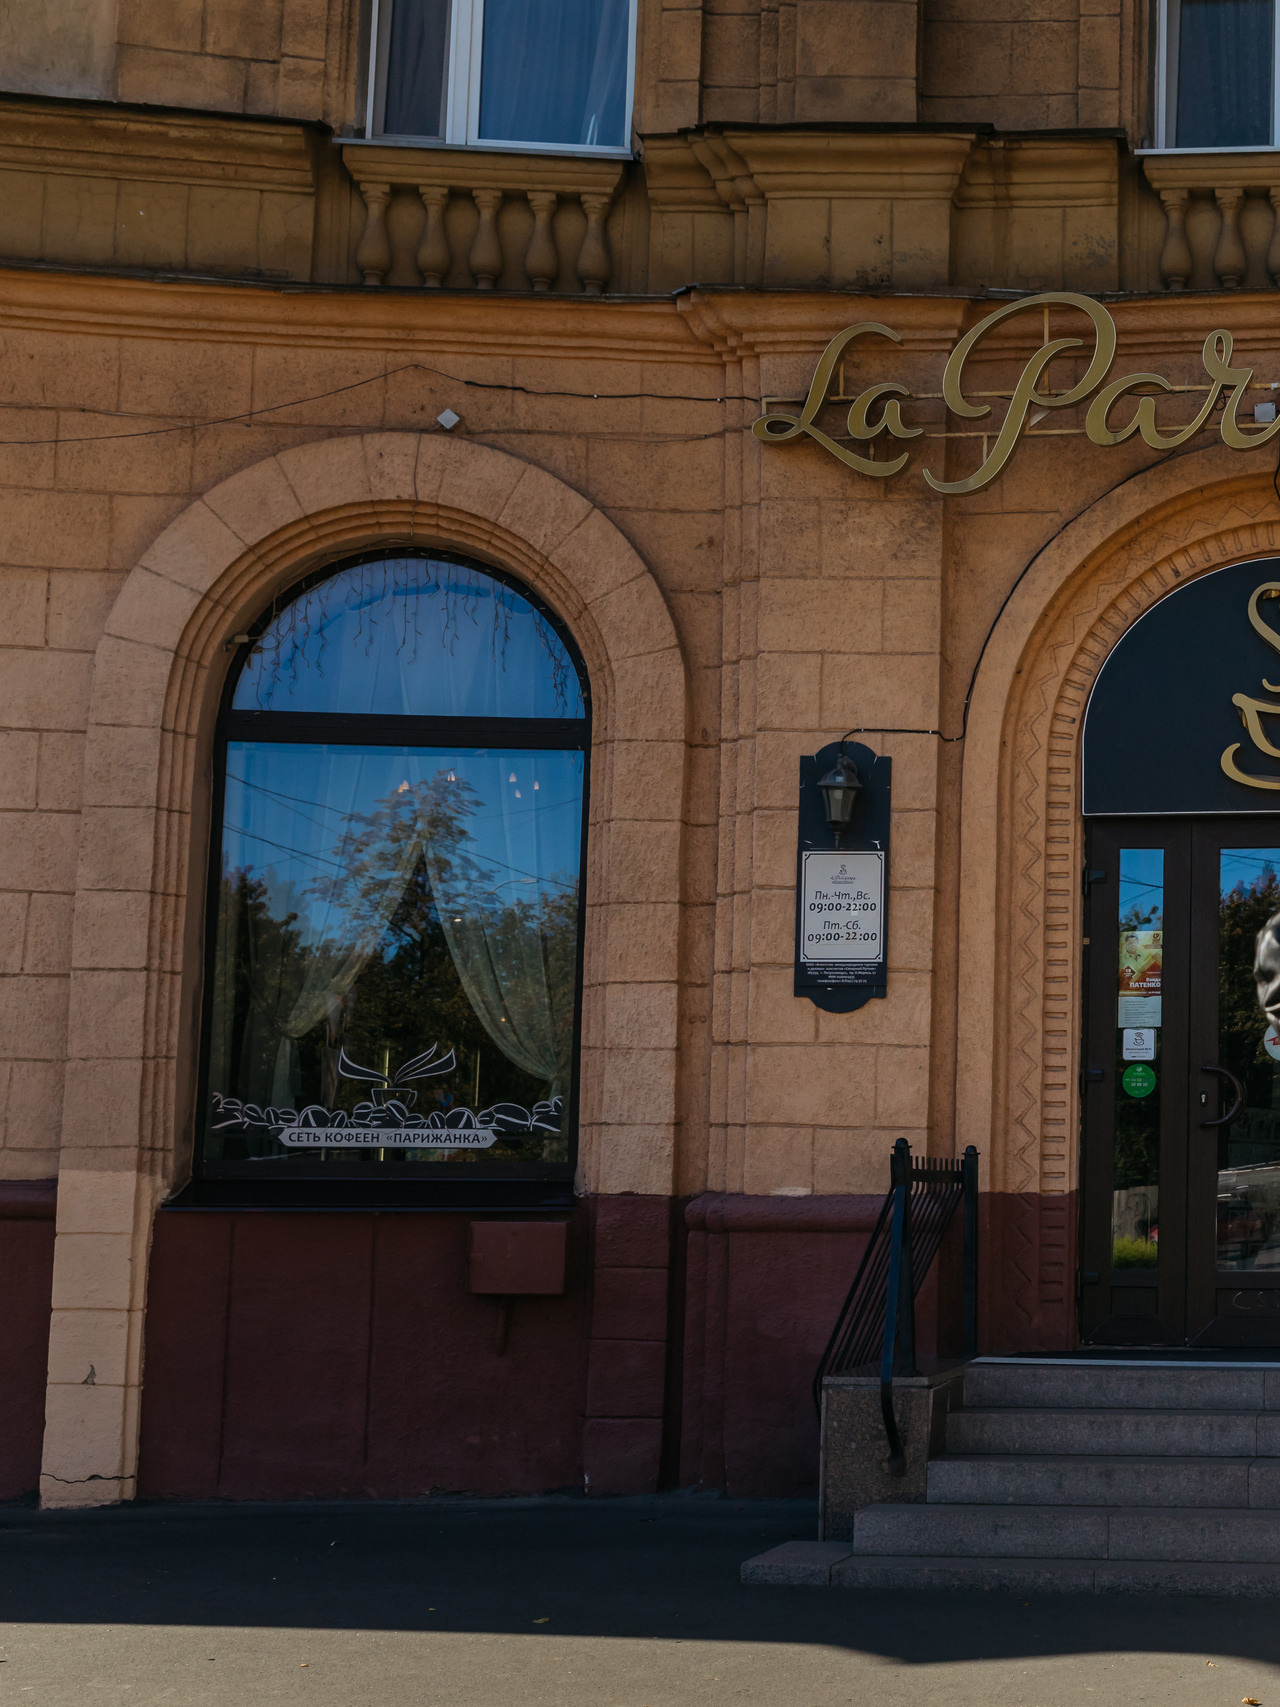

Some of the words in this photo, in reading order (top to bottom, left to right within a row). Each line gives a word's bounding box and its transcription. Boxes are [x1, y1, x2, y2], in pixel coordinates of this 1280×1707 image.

[753, 321, 925, 477] La
[809, 902, 877, 914] 09:00-22:00
[823, 920, 861, 930] Пт.-Сб.
[288, 1132, 321, 1144] СЕТЬ
[324, 1132, 381, 1144] КОФЕЕН
[386, 1132, 488, 1145] «ПАРИЖАНКА»
